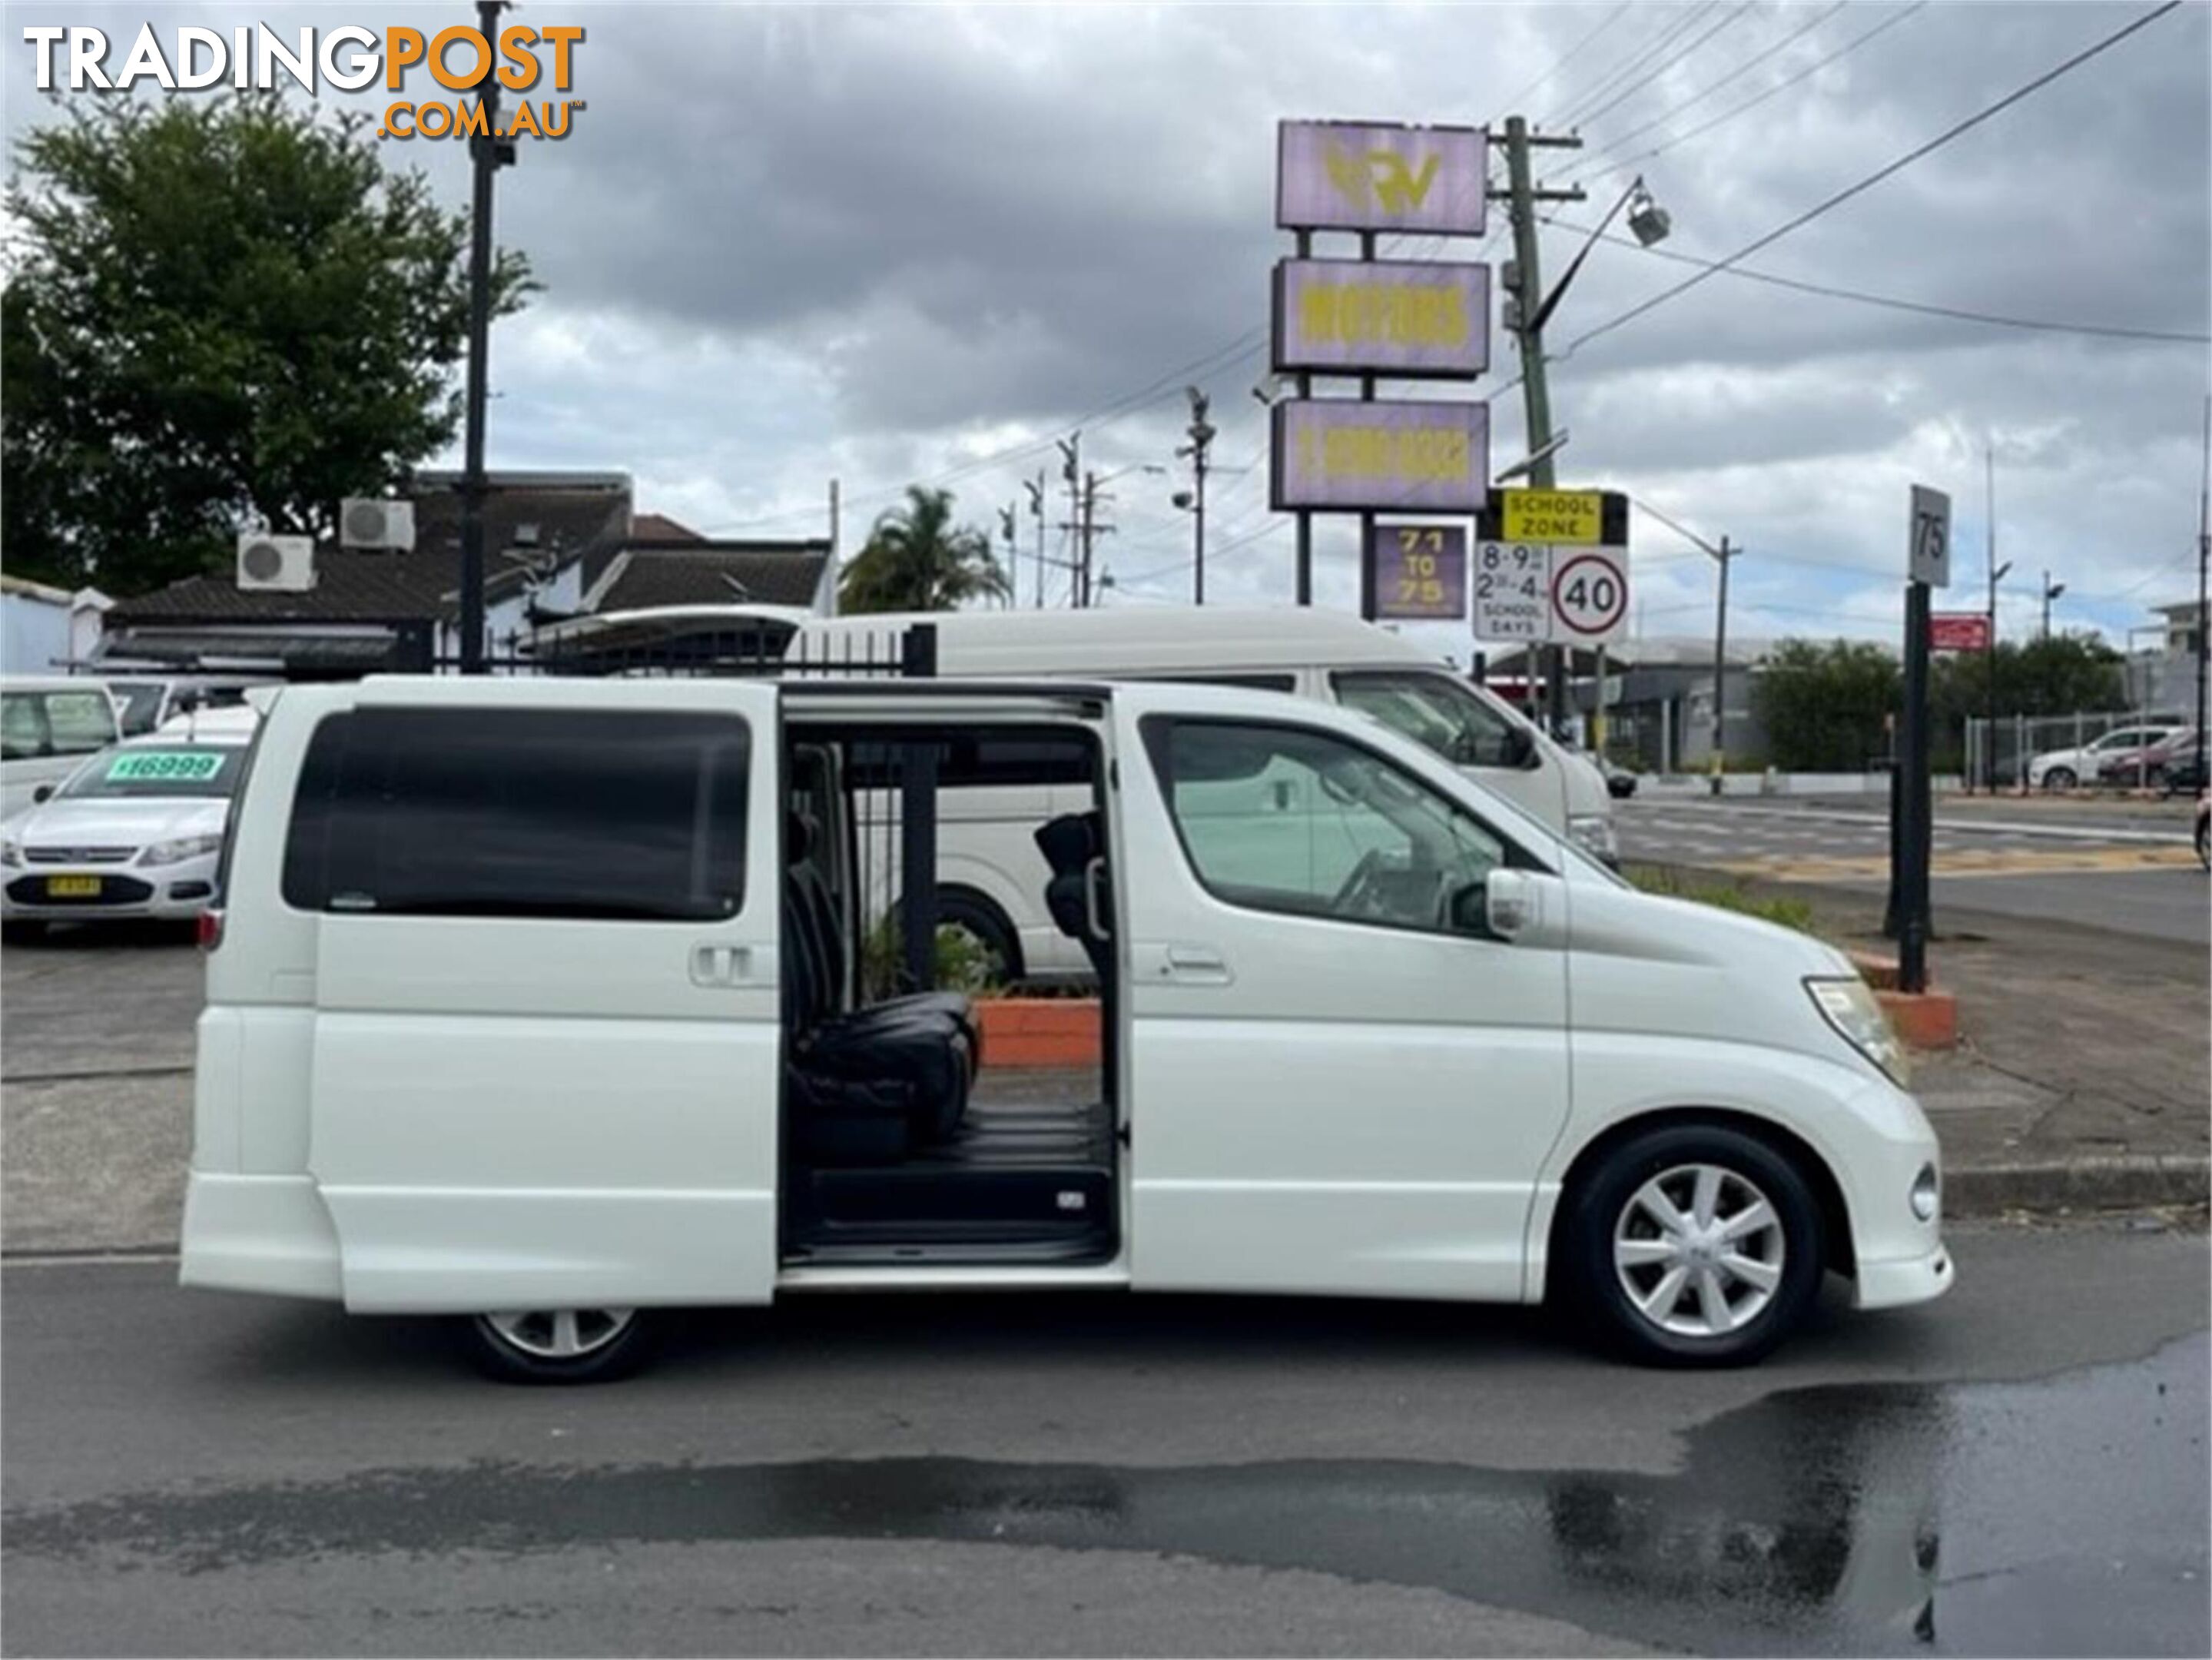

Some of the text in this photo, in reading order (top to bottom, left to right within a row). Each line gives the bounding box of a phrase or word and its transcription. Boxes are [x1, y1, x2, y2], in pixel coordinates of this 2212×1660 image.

[1511, 496, 1595, 516] SCHOOL
[1522, 517, 1580, 536] ZONE
[1919, 512, 1945, 559] 75
[1398, 530, 1444, 552] 71
[1405, 555, 1436, 576] TO
[1398, 579, 1444, 602] 75
[1564, 576, 1614, 612] 40
